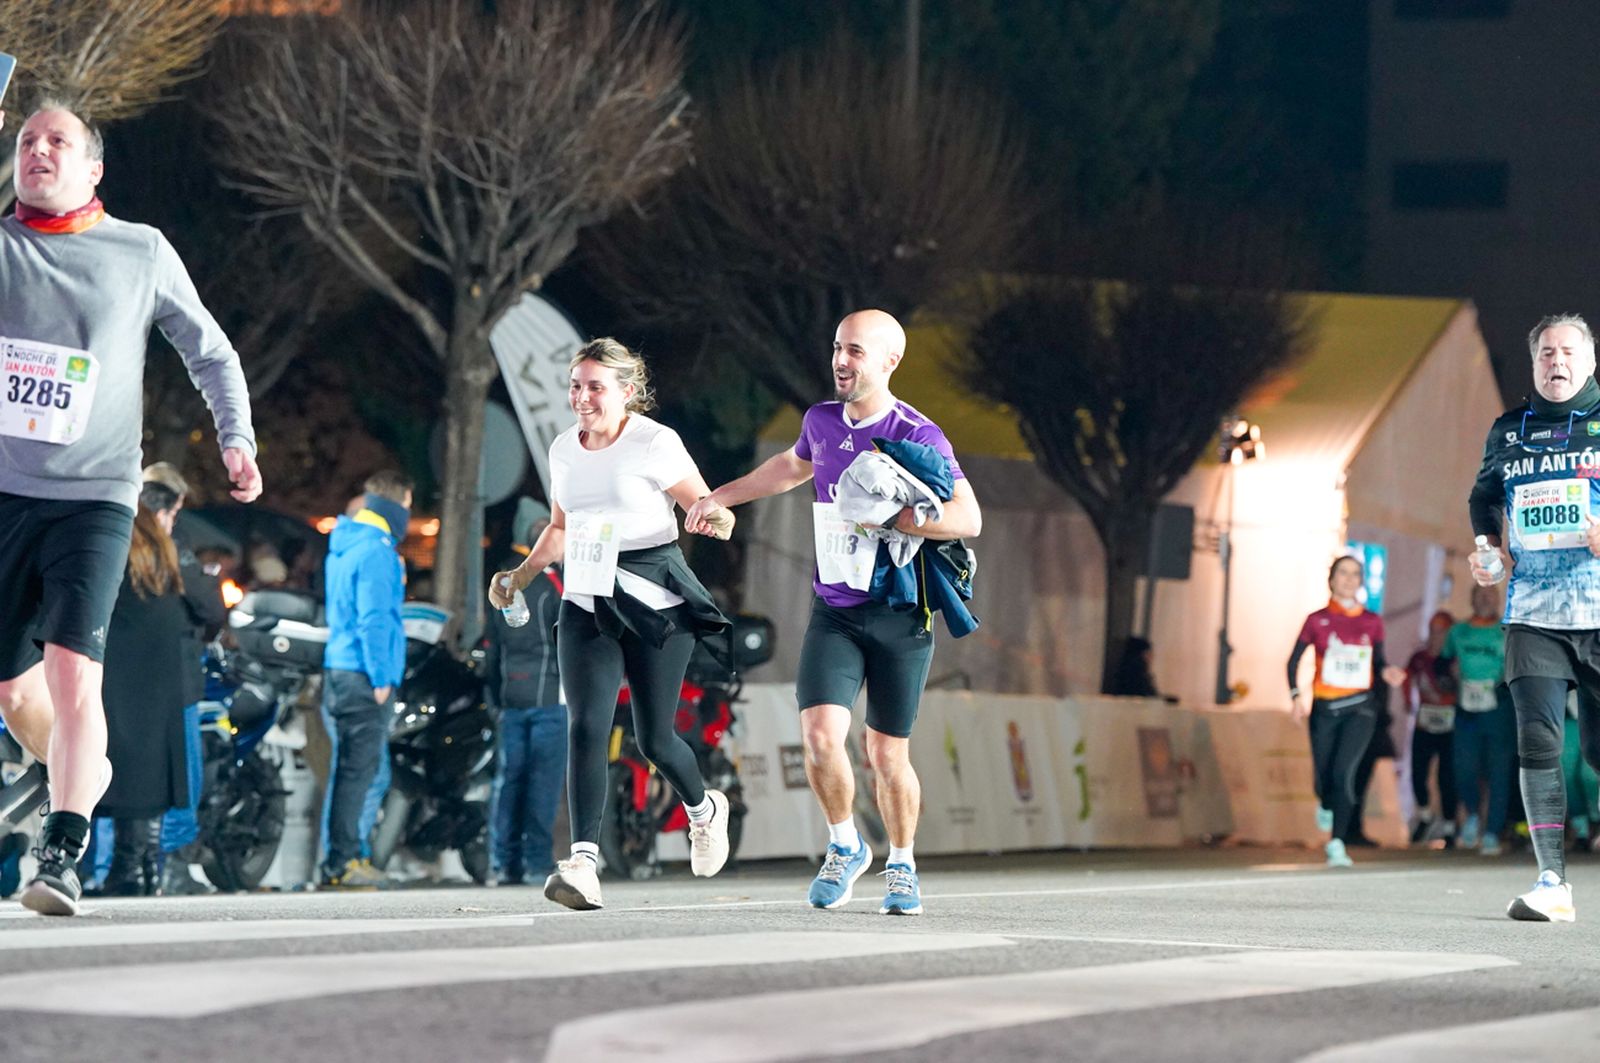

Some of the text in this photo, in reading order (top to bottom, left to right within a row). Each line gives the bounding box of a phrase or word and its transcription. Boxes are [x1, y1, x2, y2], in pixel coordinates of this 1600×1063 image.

[5, 361, 20, 372] SAN
[14, 351, 44, 363] NOCHE
[46, 355, 57, 365] DE
[8, 375, 72, 410] 3285
[1504, 457, 1534, 480] SAN
[1522, 504, 1580, 528] 13088
[571, 540, 603, 562] 3113
